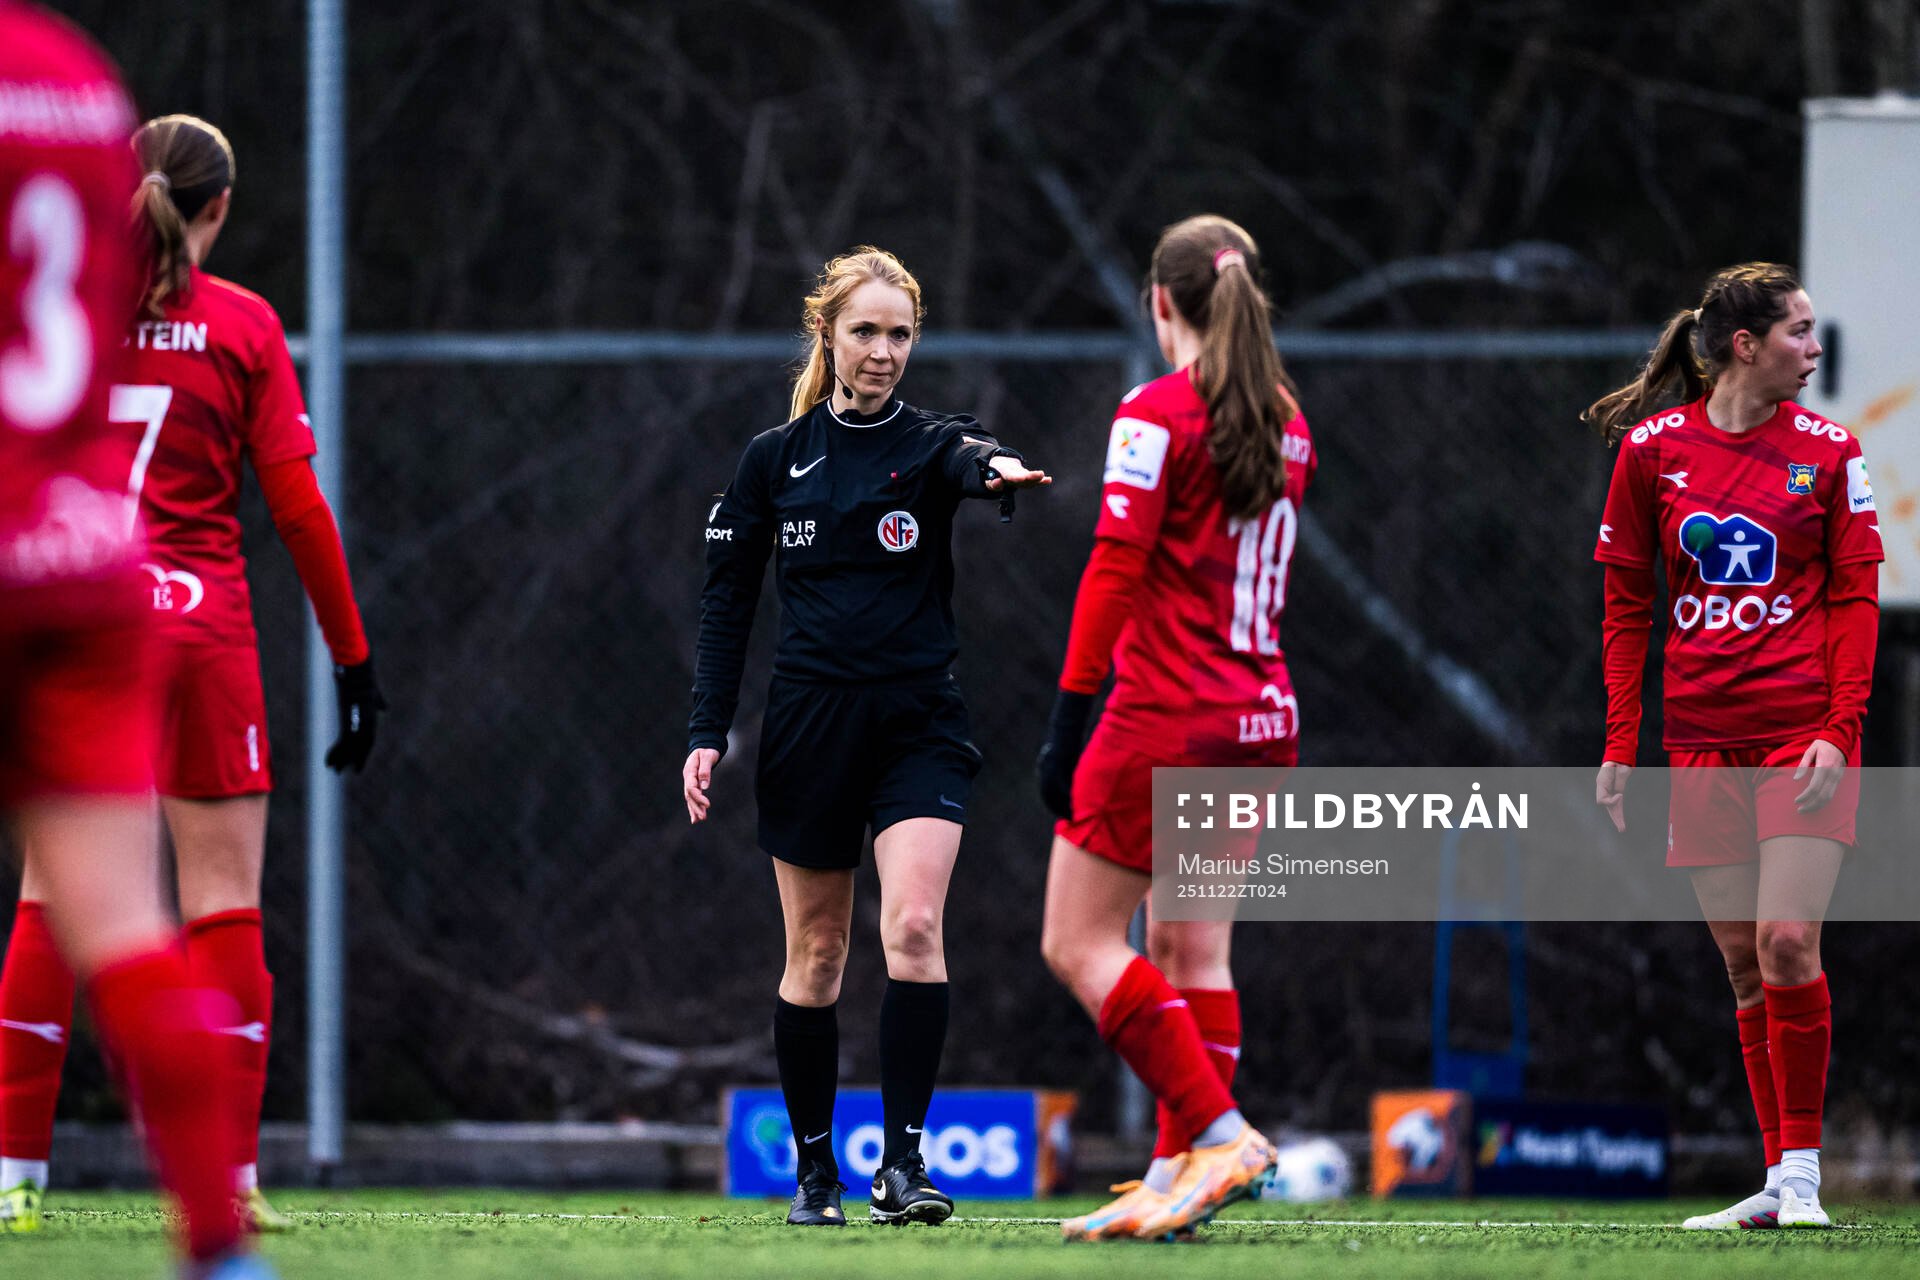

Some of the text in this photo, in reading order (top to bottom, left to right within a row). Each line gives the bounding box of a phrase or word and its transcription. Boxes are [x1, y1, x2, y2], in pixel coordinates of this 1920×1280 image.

[122, 320, 207, 352] TEIN
[1630, 412, 1685, 444] evo
[1793, 413, 1848, 442] evo
[782, 520, 816, 534] FAIR
[782, 533, 816, 548] PLAY
[1673, 594, 1794, 632] OBOS
[845, 1122, 1021, 1179] OOS
